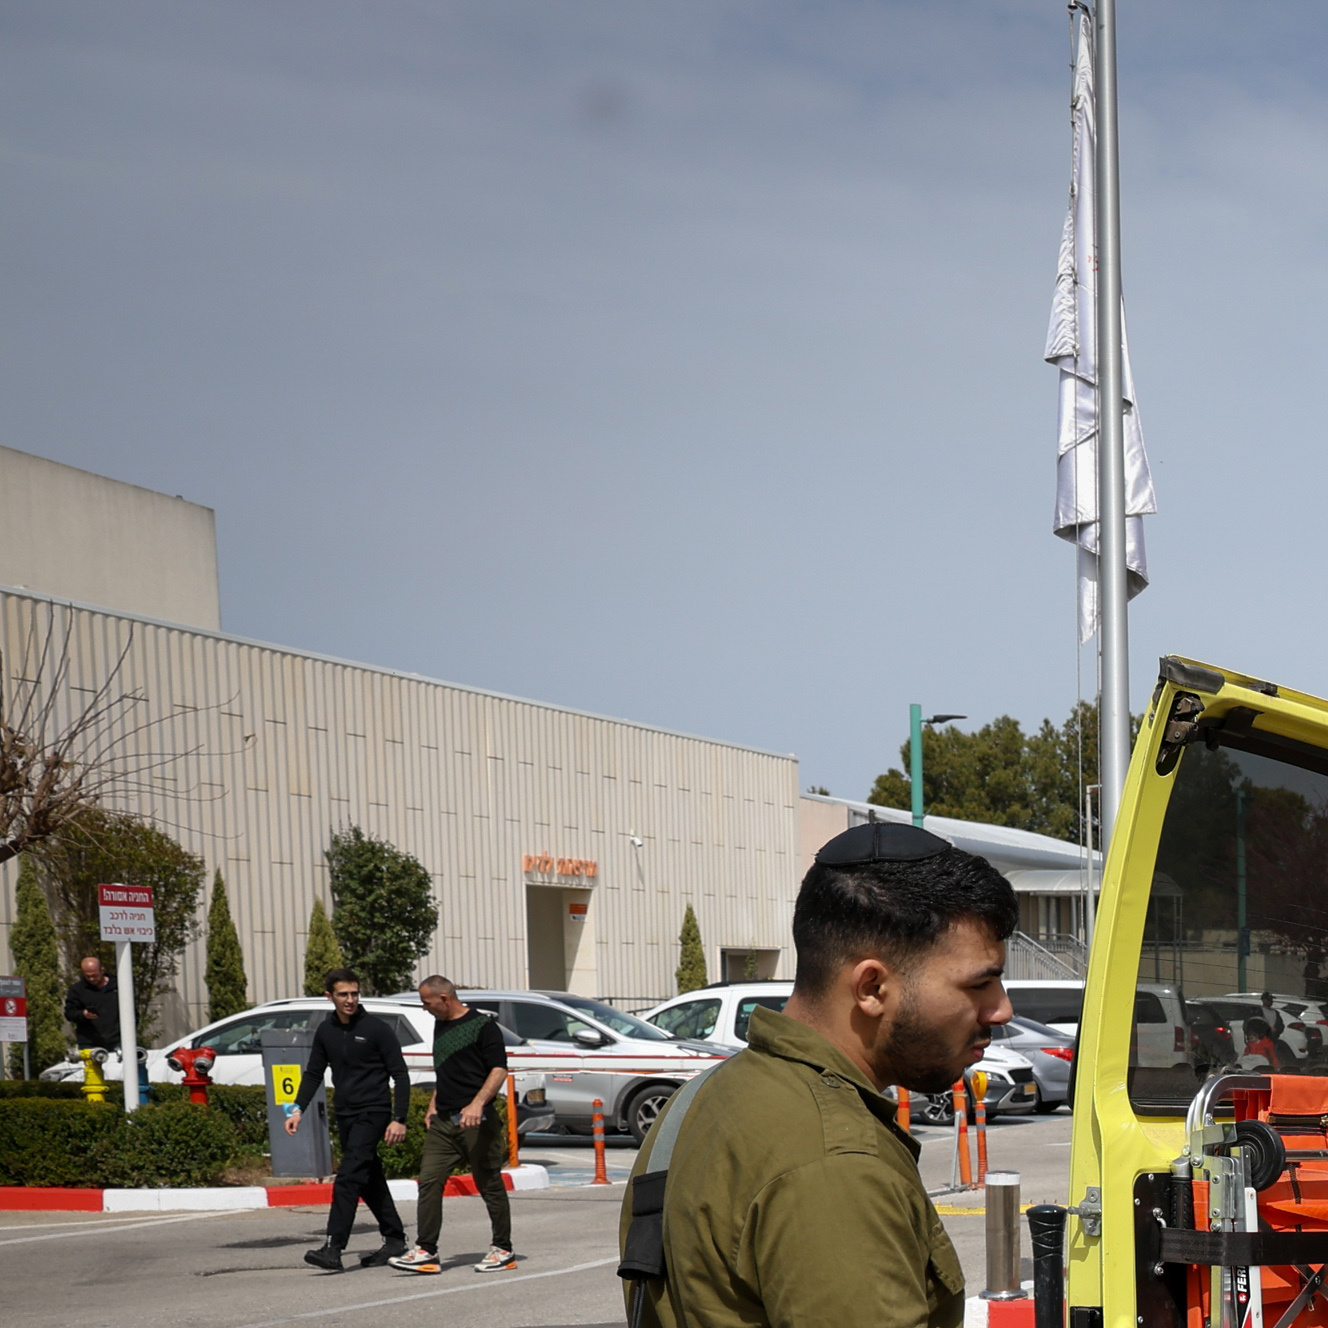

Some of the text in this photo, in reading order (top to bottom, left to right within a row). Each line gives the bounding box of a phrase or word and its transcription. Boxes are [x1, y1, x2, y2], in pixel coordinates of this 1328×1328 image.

[103, 888, 150, 902] החניה אסורה!
[109, 910, 146, 921] חניה לרכב
[103, 924, 153, 936] כיבוי אש בלבד
[282, 1077, 294, 1095] 6
